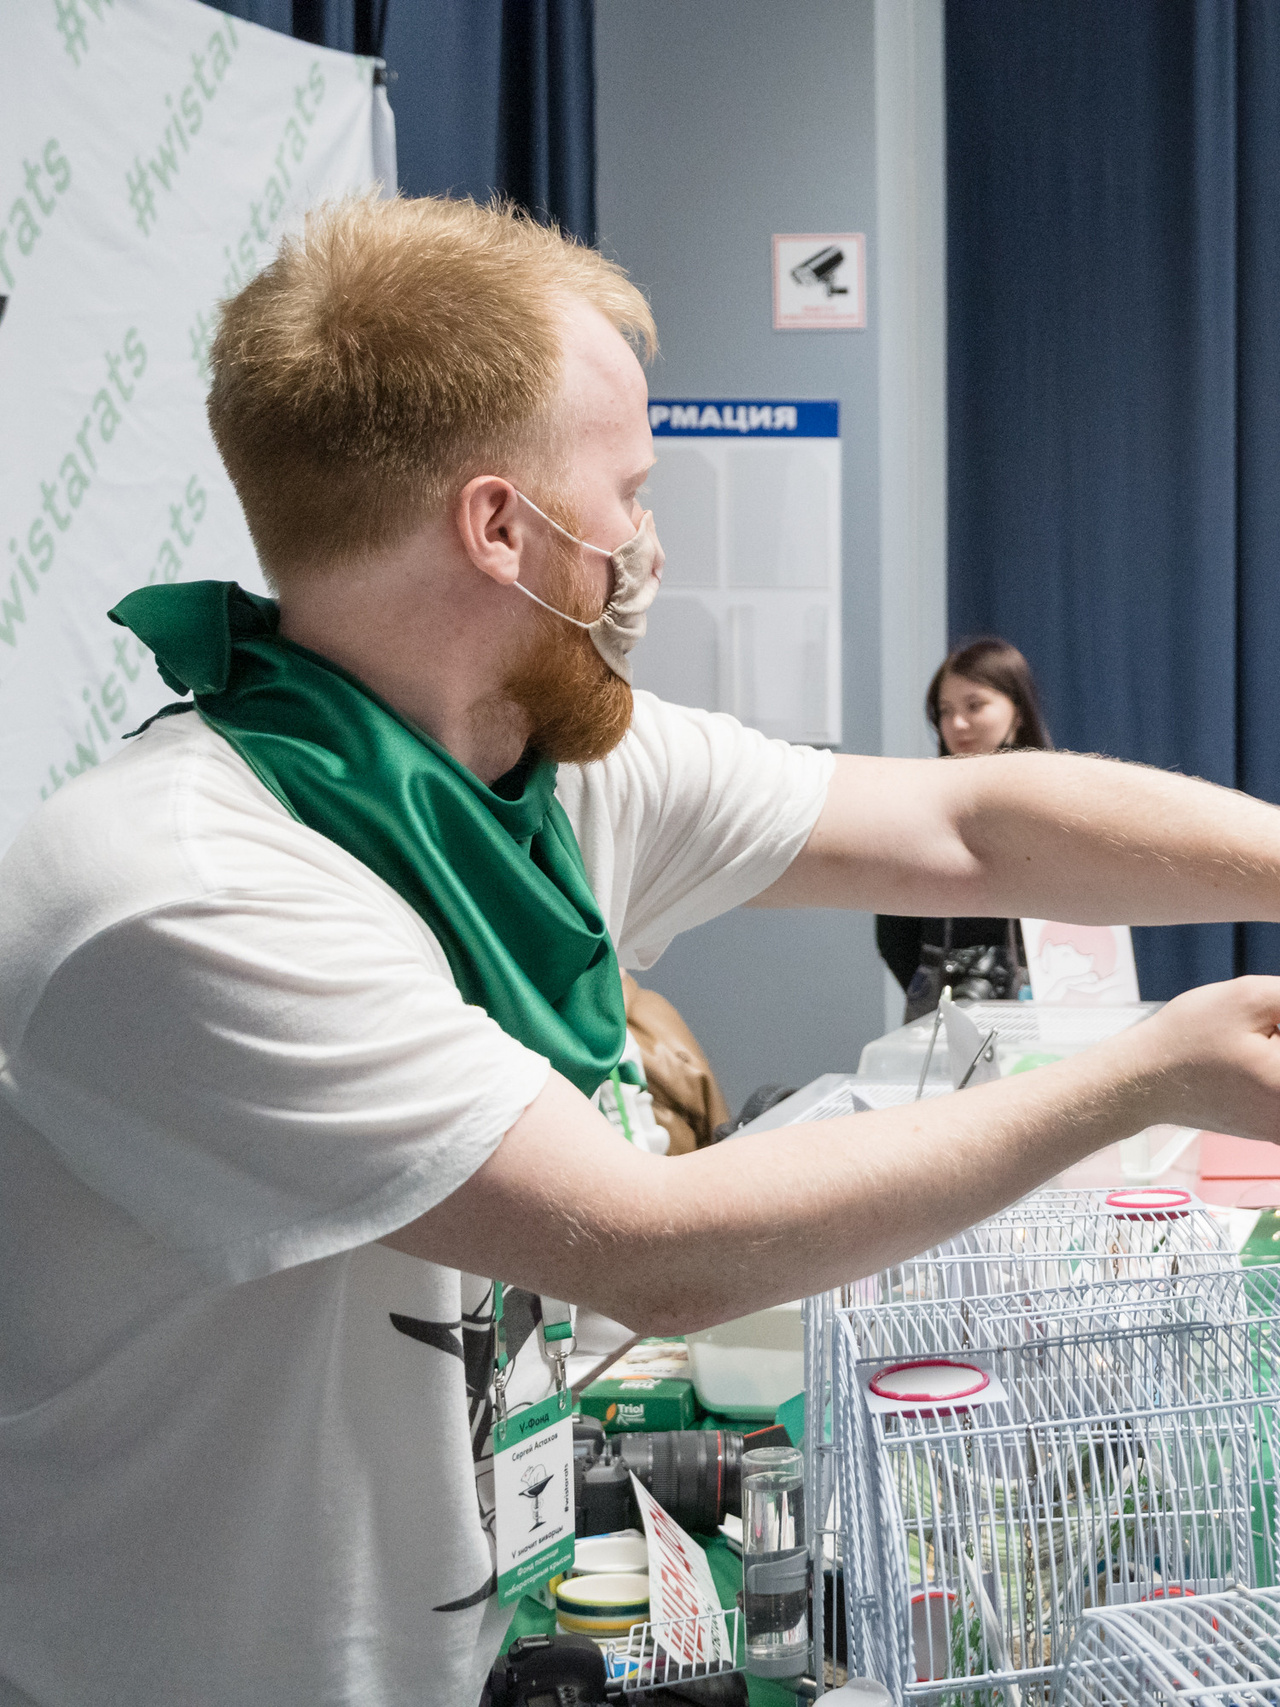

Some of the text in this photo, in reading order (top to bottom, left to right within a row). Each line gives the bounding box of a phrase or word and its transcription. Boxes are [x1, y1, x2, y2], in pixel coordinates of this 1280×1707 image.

[617, 1403, 645, 1415] Triol
[512, 1433, 558, 1461] Сергей Астахов
